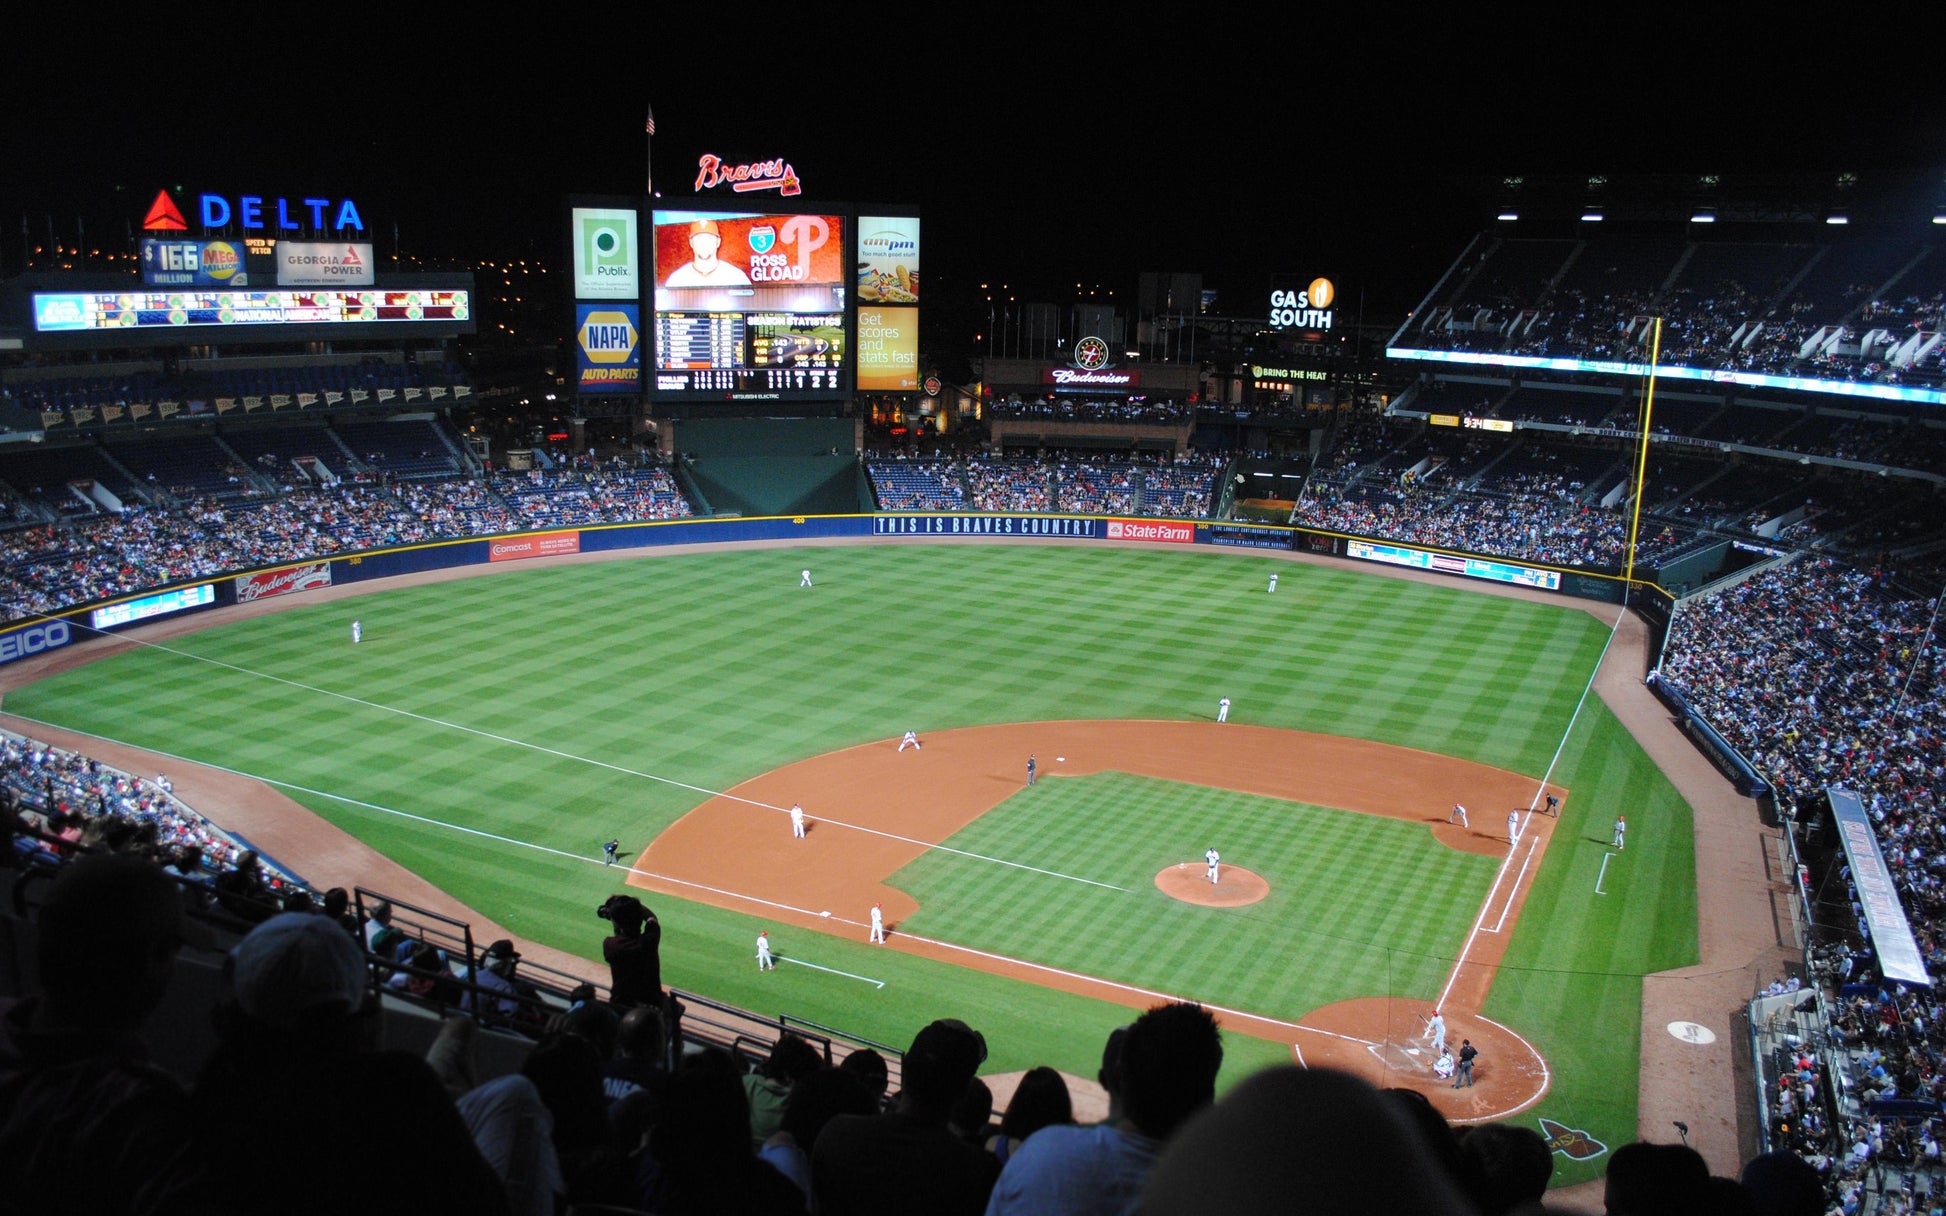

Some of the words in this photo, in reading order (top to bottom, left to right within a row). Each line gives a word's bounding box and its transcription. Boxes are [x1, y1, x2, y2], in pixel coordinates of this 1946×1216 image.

[694, 154, 784, 192] Braves
[201, 194, 364, 231] DELTA
[756, 235, 767, 248] 3
[863, 238, 915, 251] ampm
[145, 245, 153, 262] $
[160, 245, 198, 270] 166
[203, 248, 239, 264] MEGA
[251, 247, 271, 255] PITCH
[288, 255, 340, 265] GEORGIA
[750, 254, 787, 267] ROSS
[323, 266, 363, 275] POWER
[598, 266, 628, 276] Publix
[751, 265, 803, 281] GLOAD
[154, 273, 193, 283] MILLION
[1271, 290, 1308, 308] GAS
[237, 309, 282, 321] NATIONAL
[285, 308, 331, 321] AMERICAN
[787, 316, 841, 326] STATISTICS
[859, 312, 882, 326] Get
[1270, 309, 1332, 328] SOUTH
[588, 325, 629, 349] NAPA
[859, 327, 899, 338] scores
[859, 338, 883, 350] and
[777, 347, 783, 355] 0
[859, 351, 889, 363] stats
[892, 350, 915, 363] fast
[581, 368, 608, 380] AUTO
[608, 368, 639, 380] PARTS
[1052, 370, 1130, 384] Budweiser
[1263, 368, 1288, 377] BRING
[1290, 370, 1304, 379] THE
[1306, 371, 1327, 380] HEAT
[812, 376, 820, 388] 2
[829, 376, 837, 388] 2
[878, 517, 917, 533] THIS
[926, 517, 943, 533] IS
[952, 517, 1012, 533] BRAVES
[1021, 518, 1091, 535] COUNTRY
[1308, 534, 1330, 547] Coke
[493, 543, 532, 556] Comcast
[240, 563, 318, 600] Budweiser
